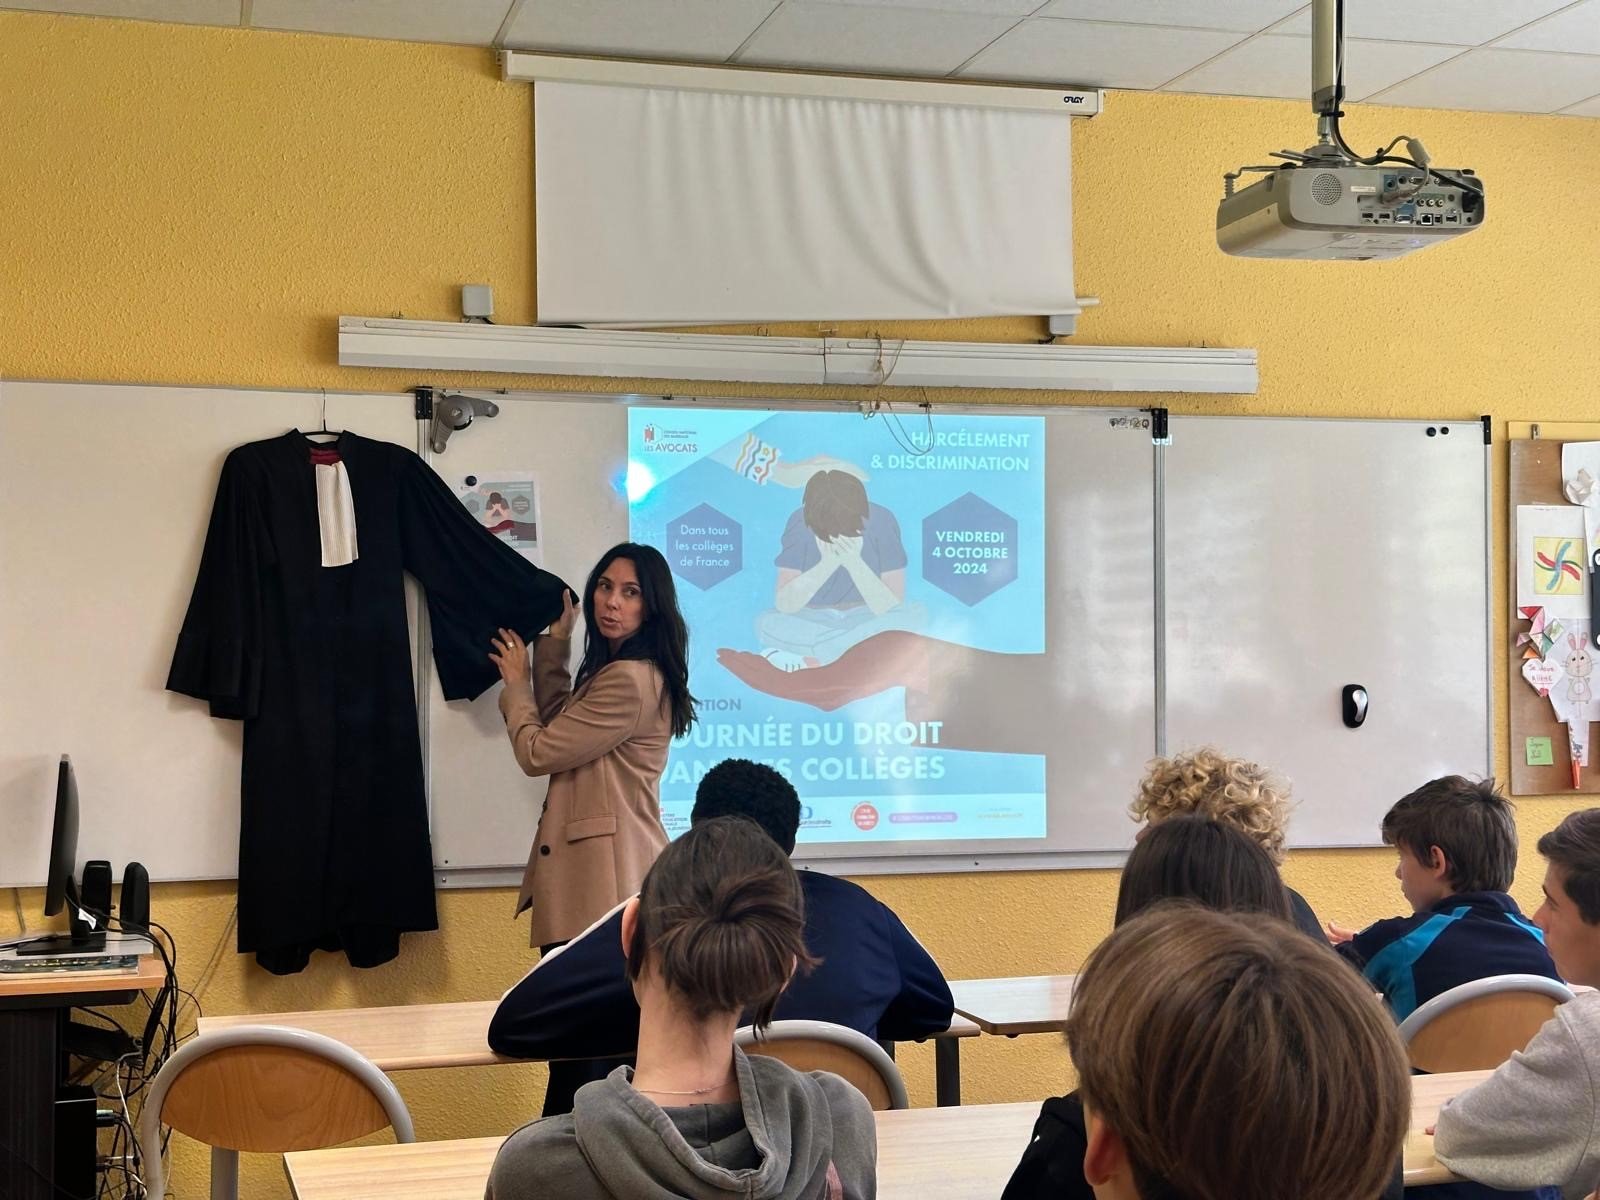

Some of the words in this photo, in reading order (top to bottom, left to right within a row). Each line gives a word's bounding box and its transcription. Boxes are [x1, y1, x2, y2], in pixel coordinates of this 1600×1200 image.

[911, 429, 1030, 448] HARCÉLEMENT
[655, 443, 698, 453] AVOCATS
[870, 454, 884, 470] &
[888, 454, 1030, 472] DISCRIMINATION
[680, 524, 706, 536] Dans
[708, 527, 729, 536] tous
[935, 530, 1005, 543] VENDREDI
[675, 540, 690, 552] les
[692, 540, 734, 553] collèges
[932, 546, 942, 558] 4
[944, 546, 1009, 559] OCTOBRE
[680, 556, 694, 567] de
[696, 555, 730, 567] France
[953, 562, 988, 575] 2024
[801, 721, 843, 747] DU
[853, 721, 944, 745] DROIT
[800, 748, 945, 781] COLLÈGES
